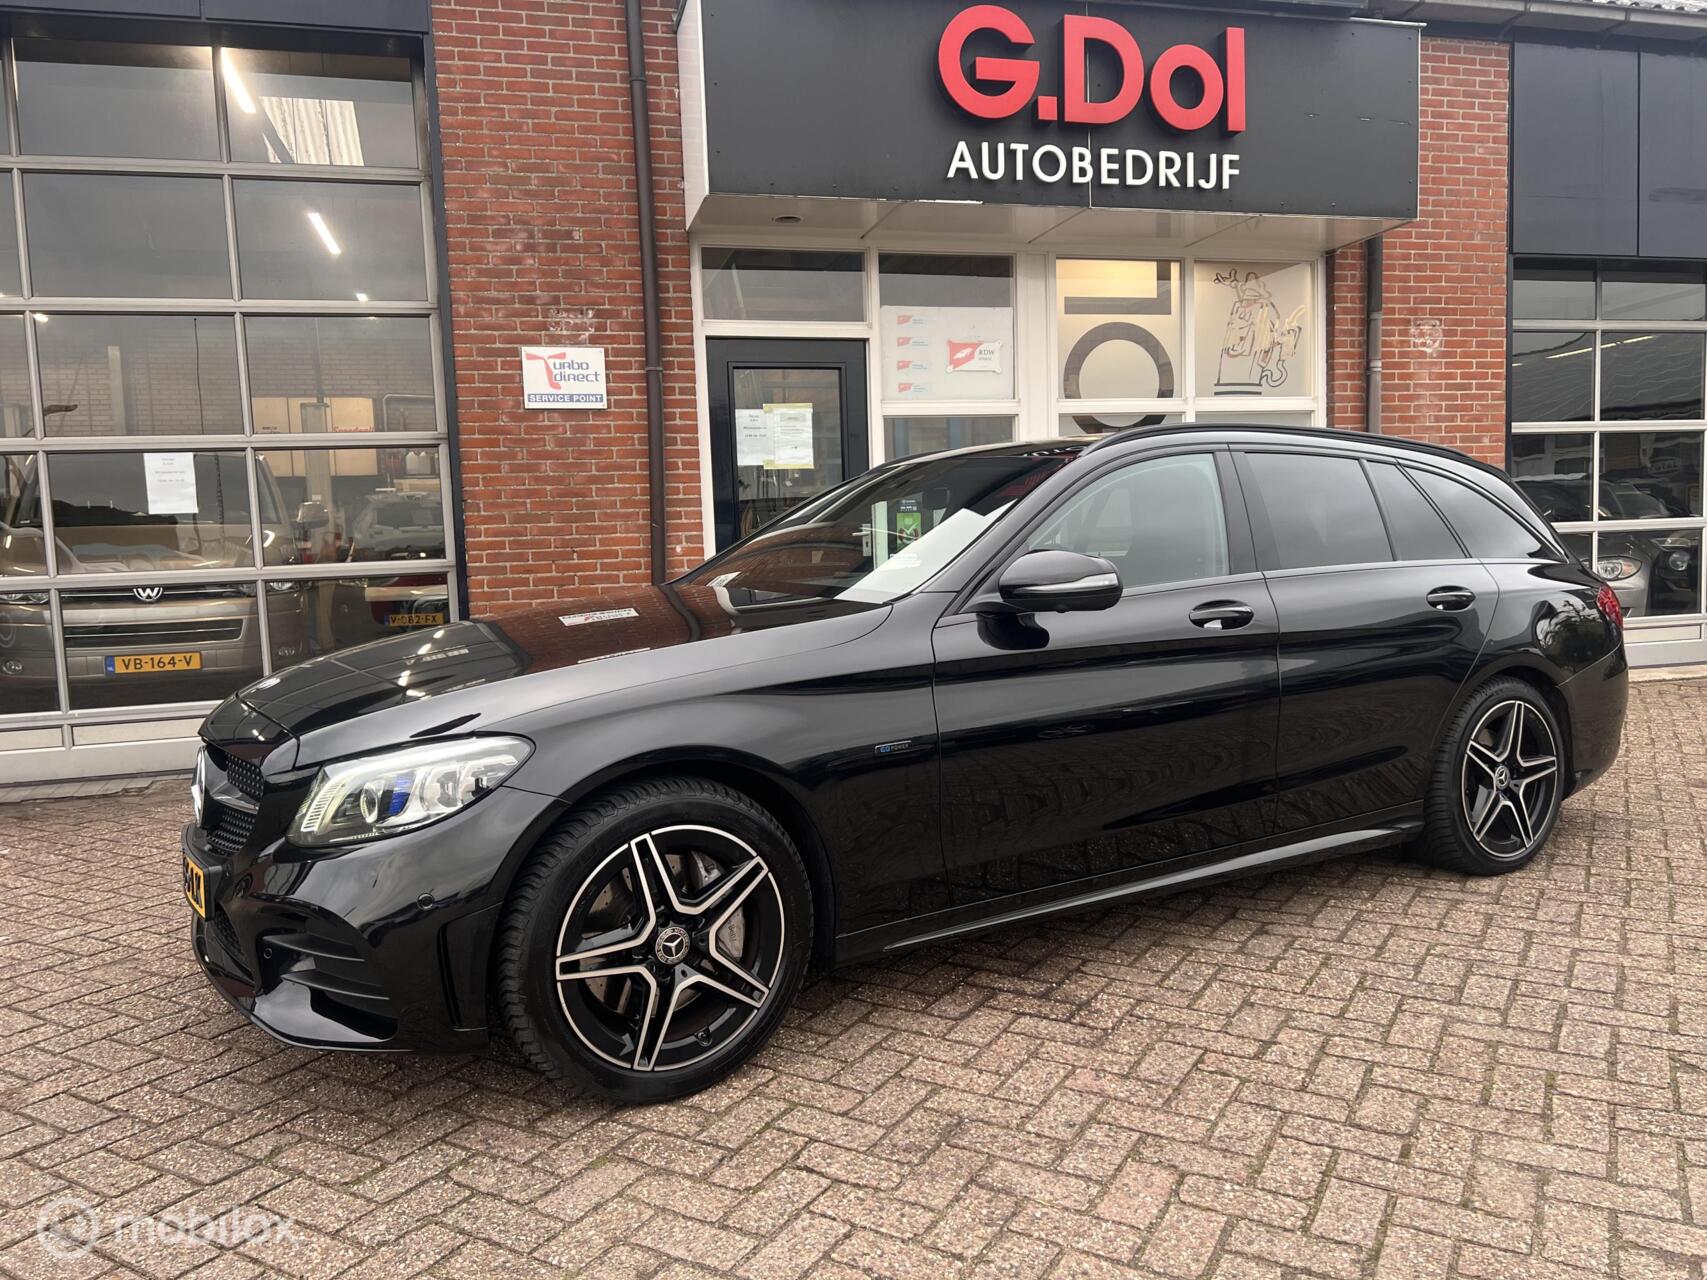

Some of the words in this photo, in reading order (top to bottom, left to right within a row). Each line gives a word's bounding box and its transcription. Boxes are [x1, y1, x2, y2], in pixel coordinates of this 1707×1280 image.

[938, 4, 1246, 132] G.Dol
[947, 140, 1240, 190] AUTOBEDRIJF
[553, 371, 601, 383] direct
[529, 394, 571, 402] SERVICE
[573, 394, 602, 402] POINT
[121, 655, 193, 671] VB-164-V
